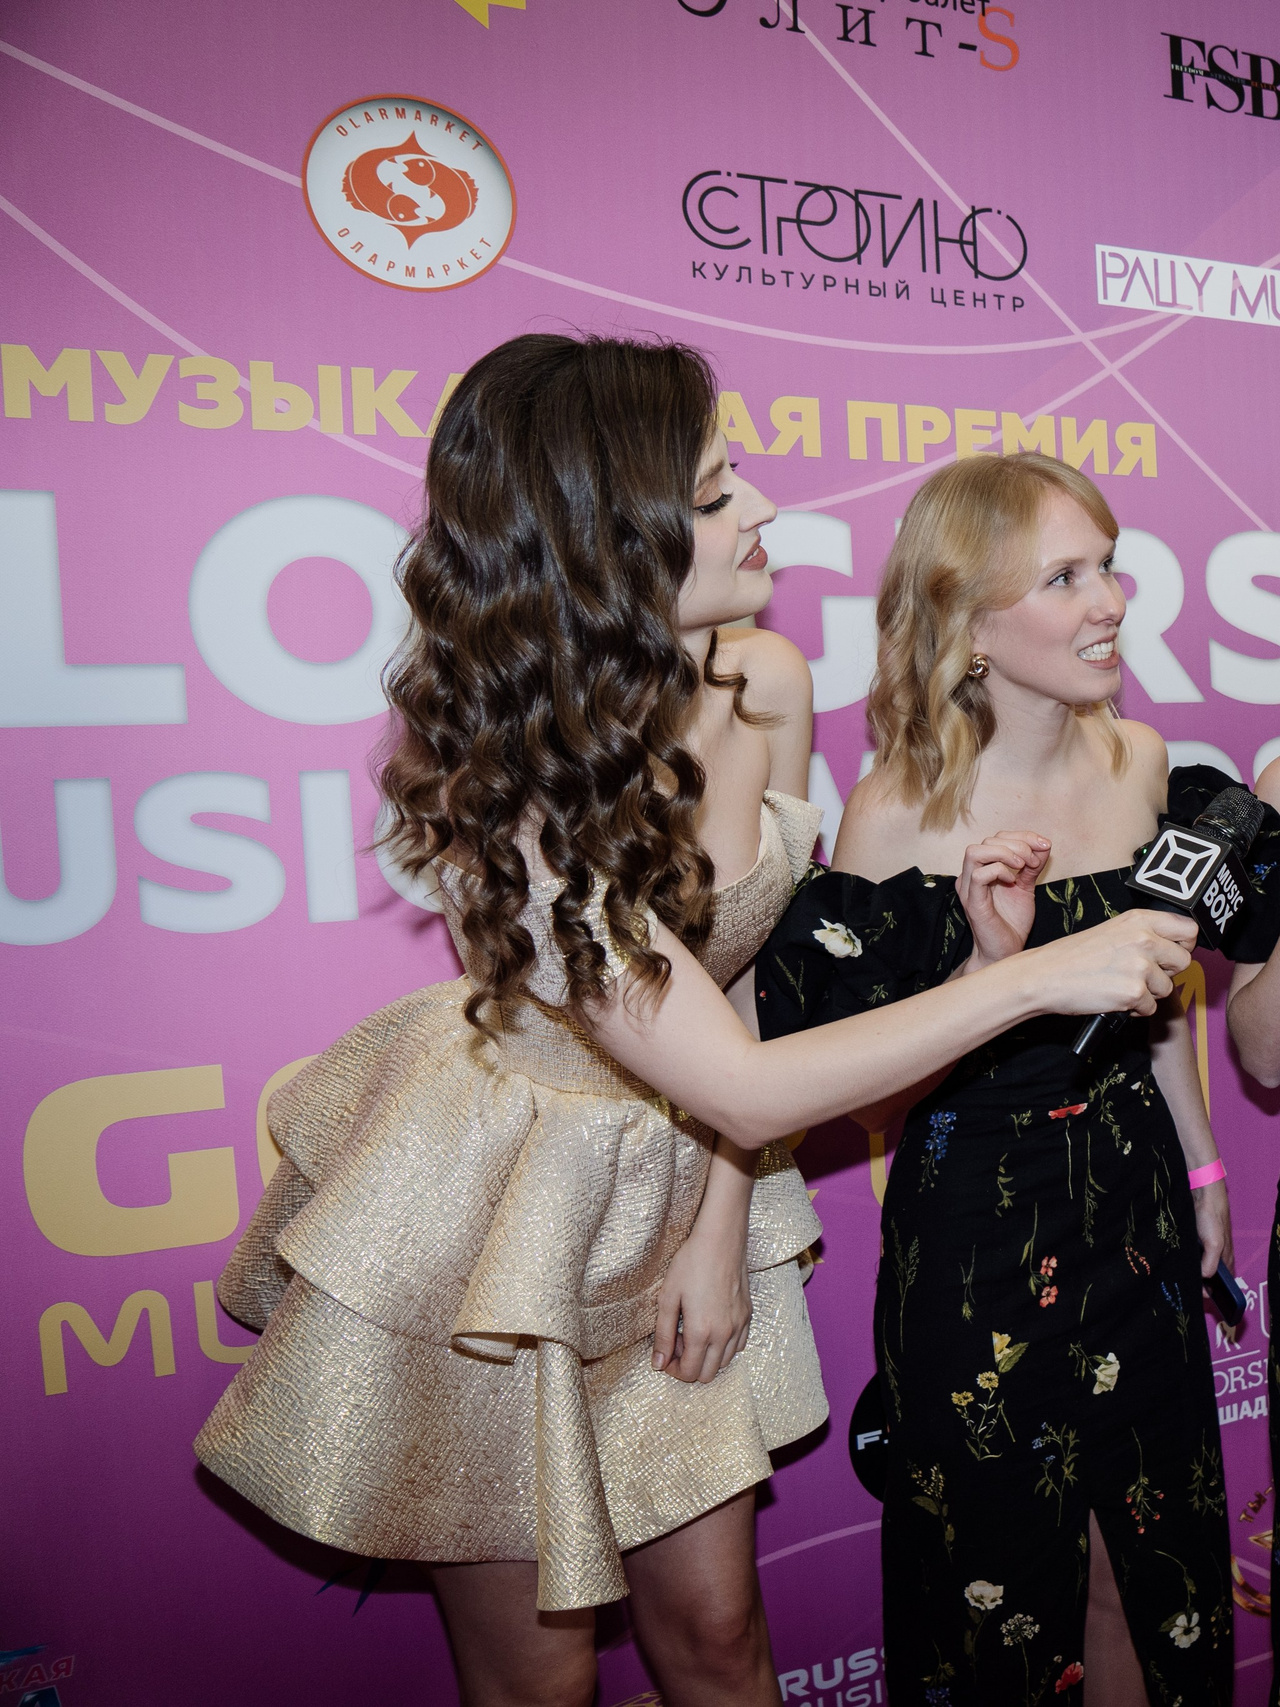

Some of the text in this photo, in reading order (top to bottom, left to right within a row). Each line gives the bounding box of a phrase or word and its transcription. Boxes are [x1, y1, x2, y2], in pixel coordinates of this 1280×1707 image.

[336, 107, 483, 151] OLARMARKET
[337, 227, 492, 279] ОЛАРМАРКЕТ
[682, 170, 1027, 282] СТРОГИНО
[691, 261, 1026, 312] КУЛЬТУРНЫЙ ЦЕНТР
[1101, 250, 1214, 312] PALLY
[1202, 878, 1234, 934] BOX
[1216, 862, 1244, 912] MUSIC
[777, 1646, 884, 1702] RUS
